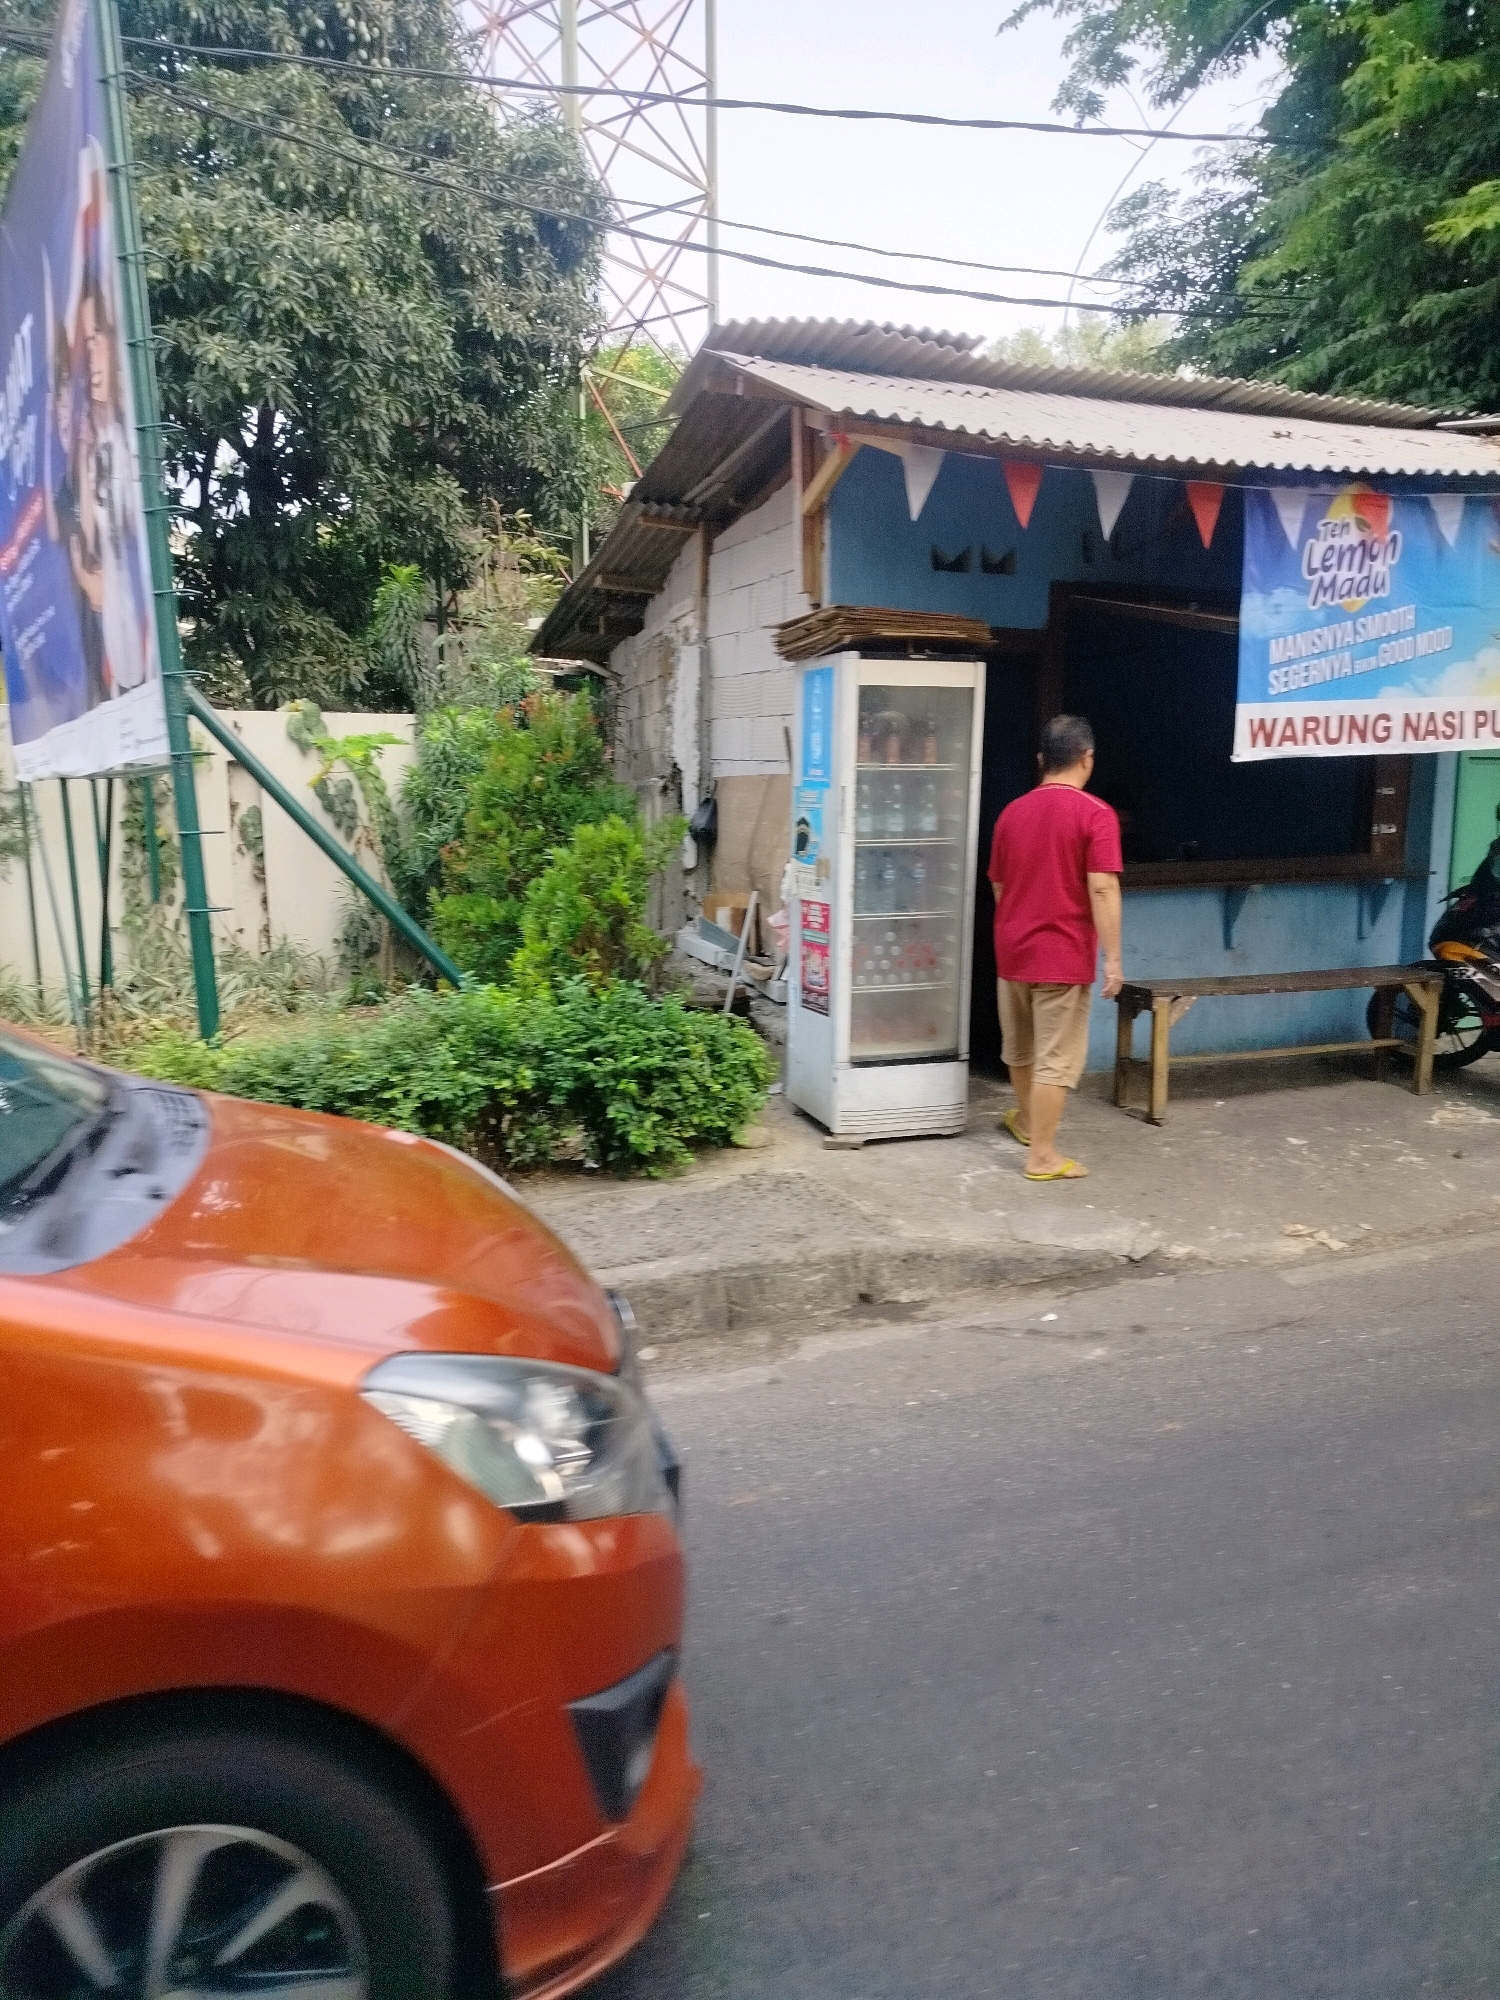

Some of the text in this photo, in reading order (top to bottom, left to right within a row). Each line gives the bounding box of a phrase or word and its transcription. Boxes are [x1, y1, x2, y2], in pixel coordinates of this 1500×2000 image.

[1319, 519, 1351, 541] Teh
[1305, 532, 1401, 577] Lemon
[1311, 571, 1388, 607] Madu
[1269, 604, 1416, 665] MANISNYA SMOOTH
[1268, 652, 1353, 696] SEGERNYA
[1377, 636, 1415, 668] GOOD
[1414, 626, 1453, 658] MOOD
[1249, 712, 1393, 748] WARUNG
[1402, 710, 1464, 742] NASI
